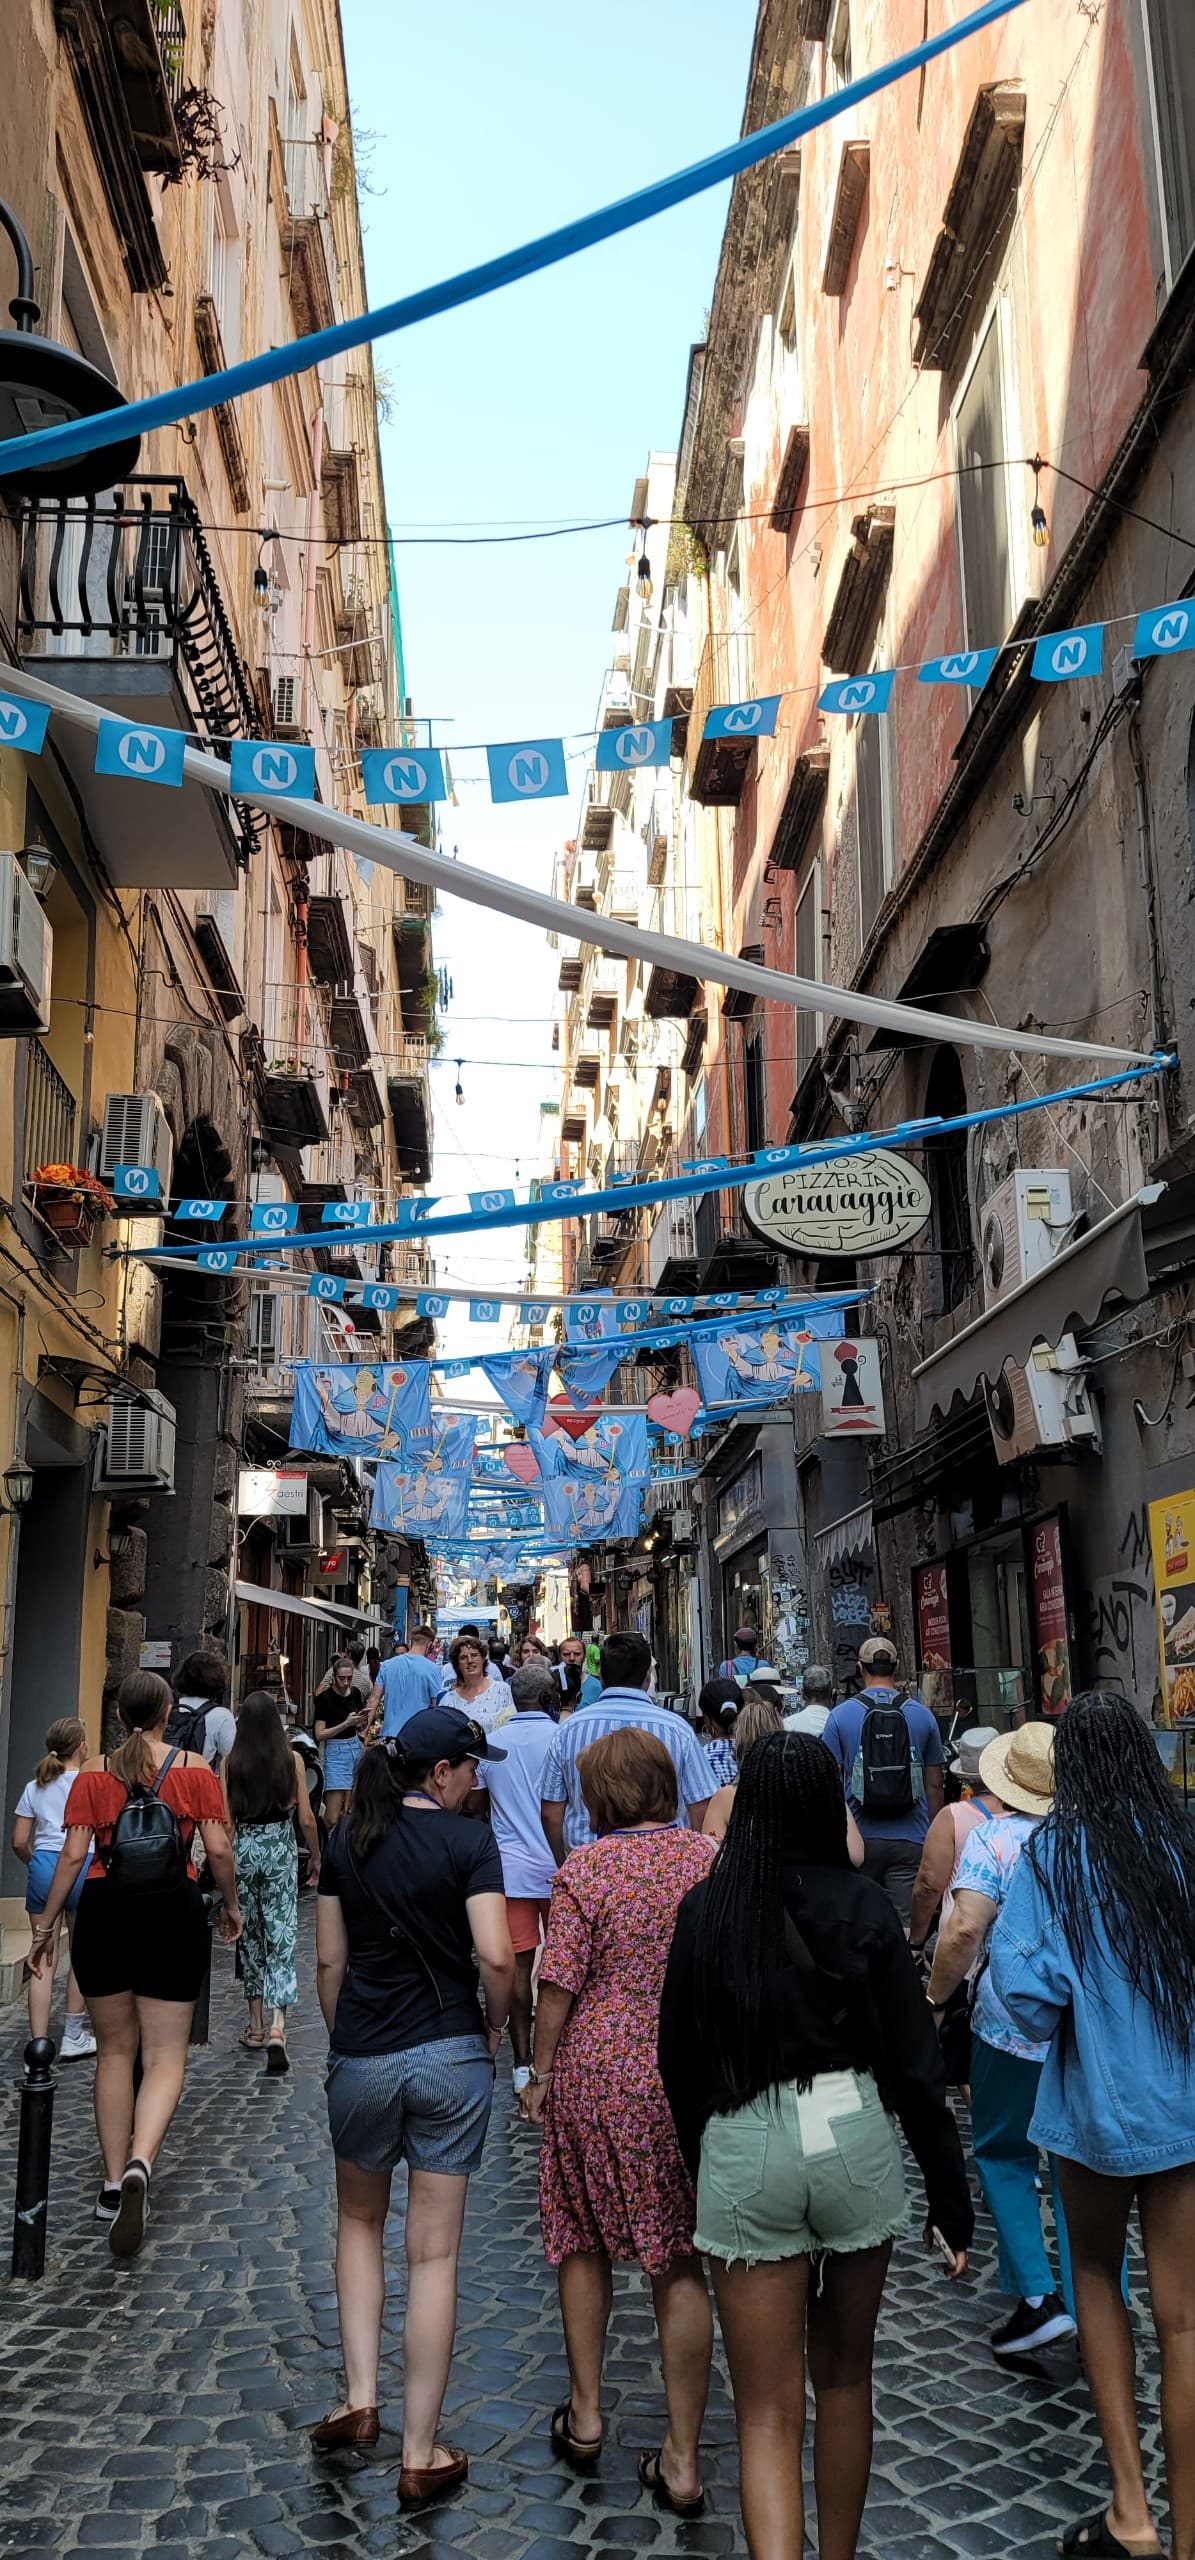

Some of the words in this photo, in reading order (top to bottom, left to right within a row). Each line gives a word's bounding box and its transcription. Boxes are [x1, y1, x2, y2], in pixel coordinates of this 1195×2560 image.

[1158, 616, 1183, 642] N
[1058, 642, 1081, 668] N
[945, 654, 973, 673] N
[844, 685, 870, 705] N
[729, 707, 756, 727] N
[127, 736, 157, 768] N
[622, 732, 648, 758] N
[261, 753, 289, 783] N
[516, 757, 542, 787] N
[391, 765, 420, 790] N
[783, 1172, 889, 1190] PIZZERIA
[192, 1203, 210, 1214] N
[485, 1195, 501, 1208] N
[751, 1181, 925, 1227] Caravaggio
[267, 1211, 284, 1225] N
[339, 1205, 355, 1217] N
[210, 1252, 224, 1267] N
[321, 1280, 334, 1294] N
[375, 1291, 387, 1305] N
[672, 1301, 684, 1310] N
[428, 1300, 440, 1312] N
[479, 1305, 490, 1317] N
[627, 1306, 637, 1317] N
[530, 1309, 541, 1321] N
[581, 1309, 591, 1320] N
